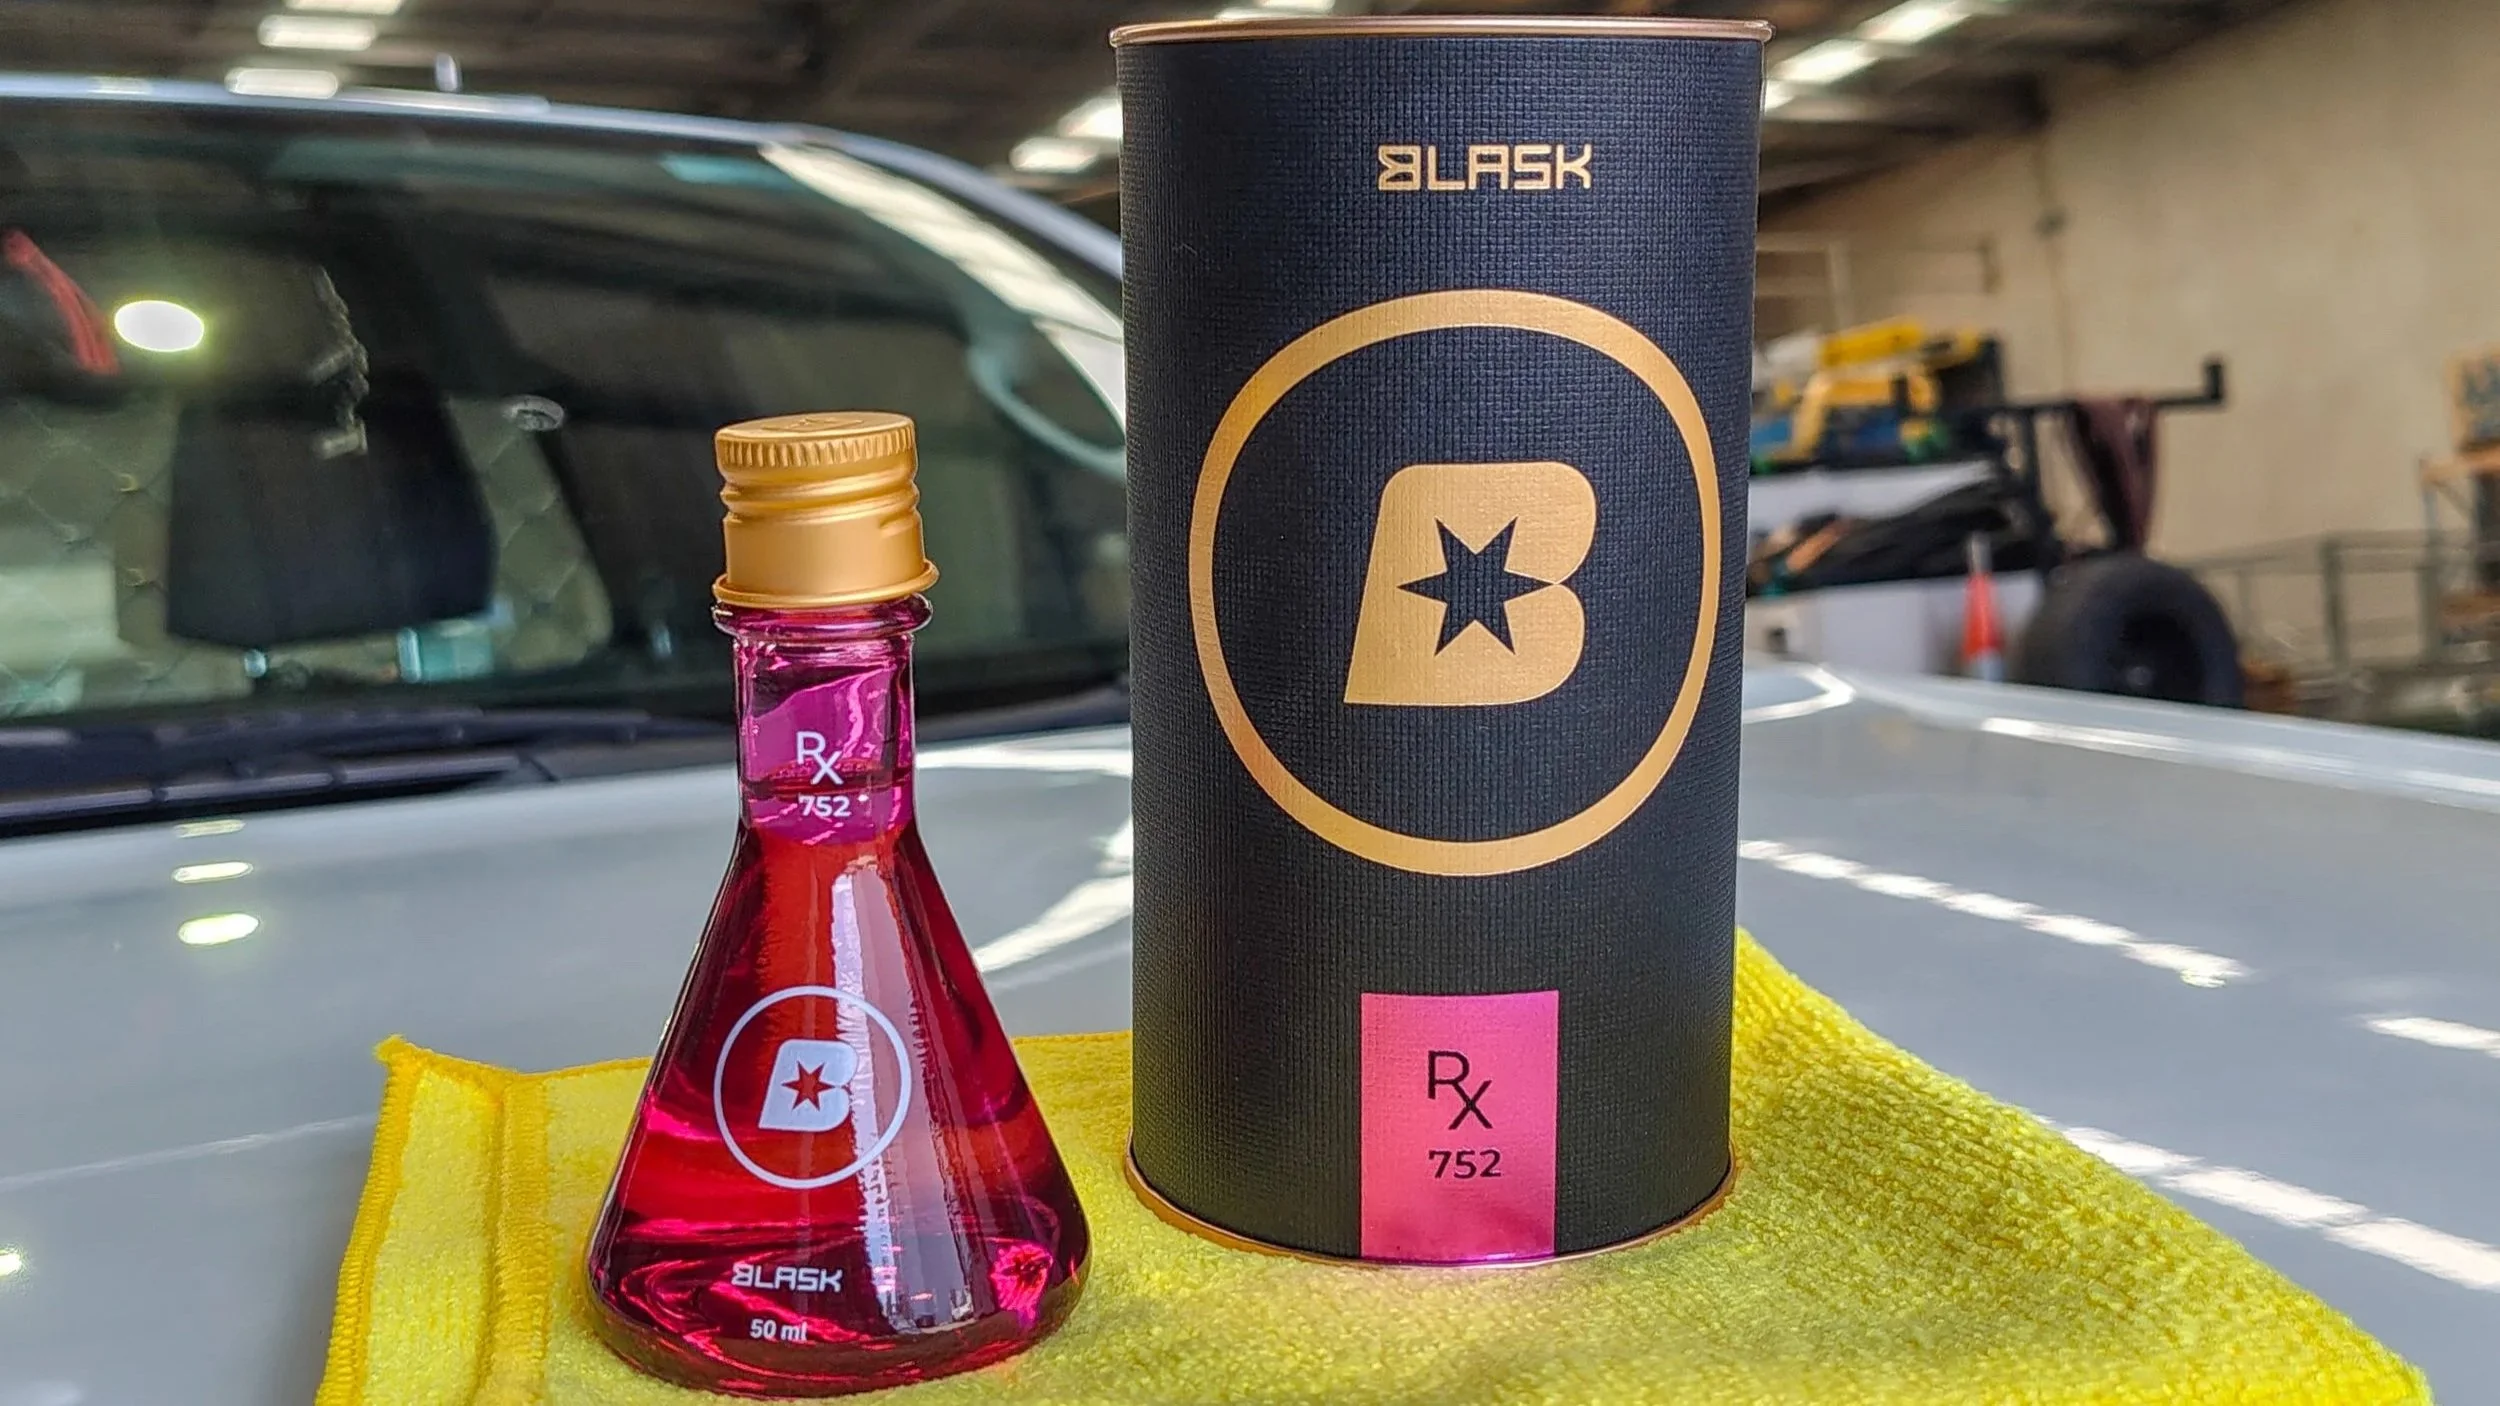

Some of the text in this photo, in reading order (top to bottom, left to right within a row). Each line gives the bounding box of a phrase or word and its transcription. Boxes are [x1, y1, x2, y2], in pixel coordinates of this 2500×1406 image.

[1377, 143, 1593, 192] BLASK
[798, 795, 851, 817] 752
[1428, 1149, 1502, 1179] 752
[732, 1264, 842, 1292] BLASK
[749, 1317, 808, 1342] 50 ml
